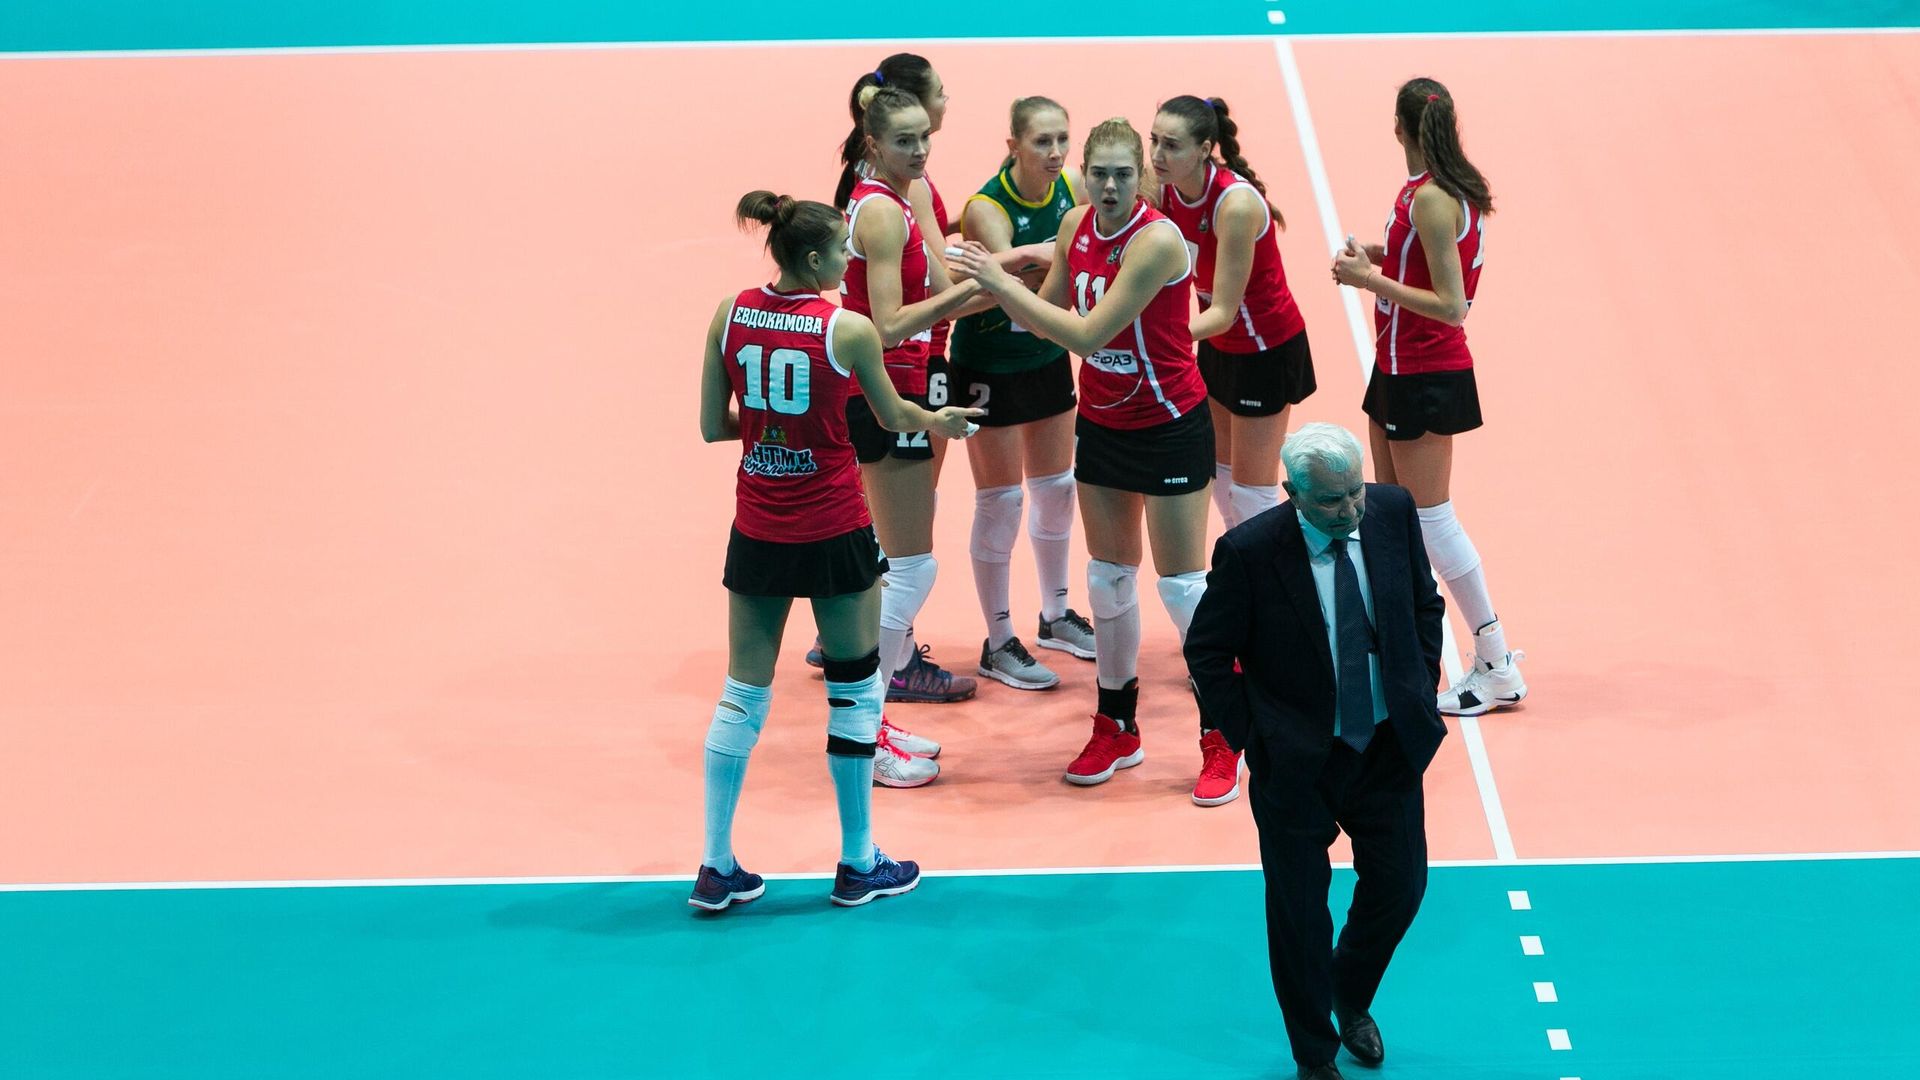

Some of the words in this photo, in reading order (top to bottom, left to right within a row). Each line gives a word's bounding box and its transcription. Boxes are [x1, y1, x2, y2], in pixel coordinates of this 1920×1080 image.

[1075, 270, 1107, 317] 11
[732, 306, 824, 335] ЕВДОКИМОВА
[735, 343, 811, 415] 10
[928, 372, 948, 406] 6
[968, 382, 991, 416] 2
